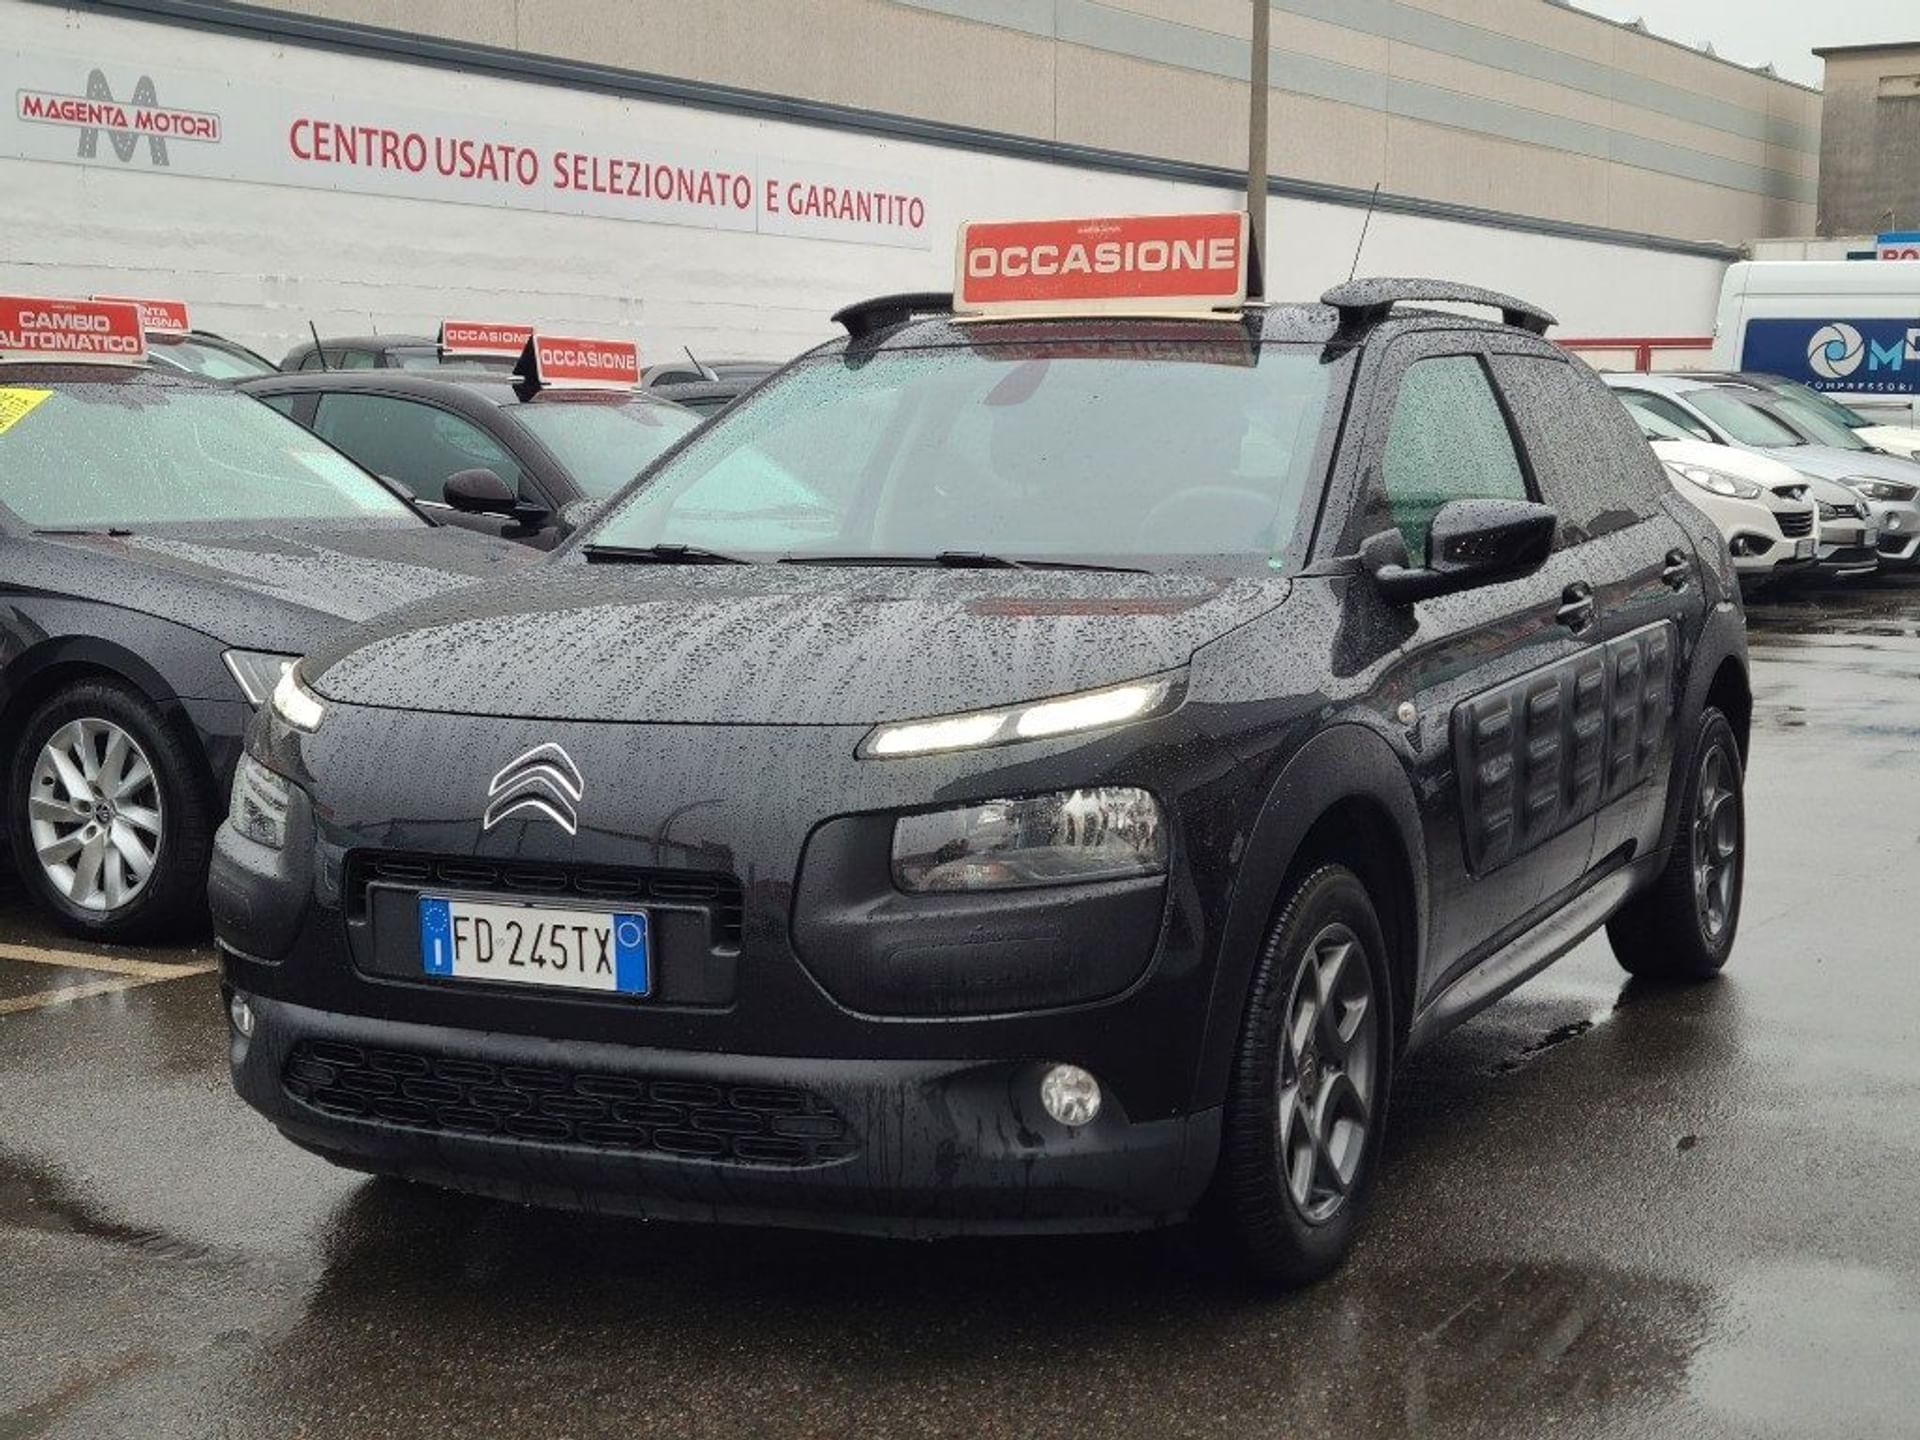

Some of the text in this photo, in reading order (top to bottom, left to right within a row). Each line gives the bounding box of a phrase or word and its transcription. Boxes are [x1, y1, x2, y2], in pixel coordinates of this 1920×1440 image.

[22, 95, 217, 139] MAGENTA MOTORI
[289, 119, 925, 229] CENTRO USATO SELEZIONATO E GARANTITO
[968, 238, 1235, 278] OCCASIONE
[18, 311, 111, 333] CAMBIO
[0, 331, 138, 354] AUTOMATICO
[541, 350, 637, 370] OCCASIONE
[453, 917, 612, 974] FD 245TX
